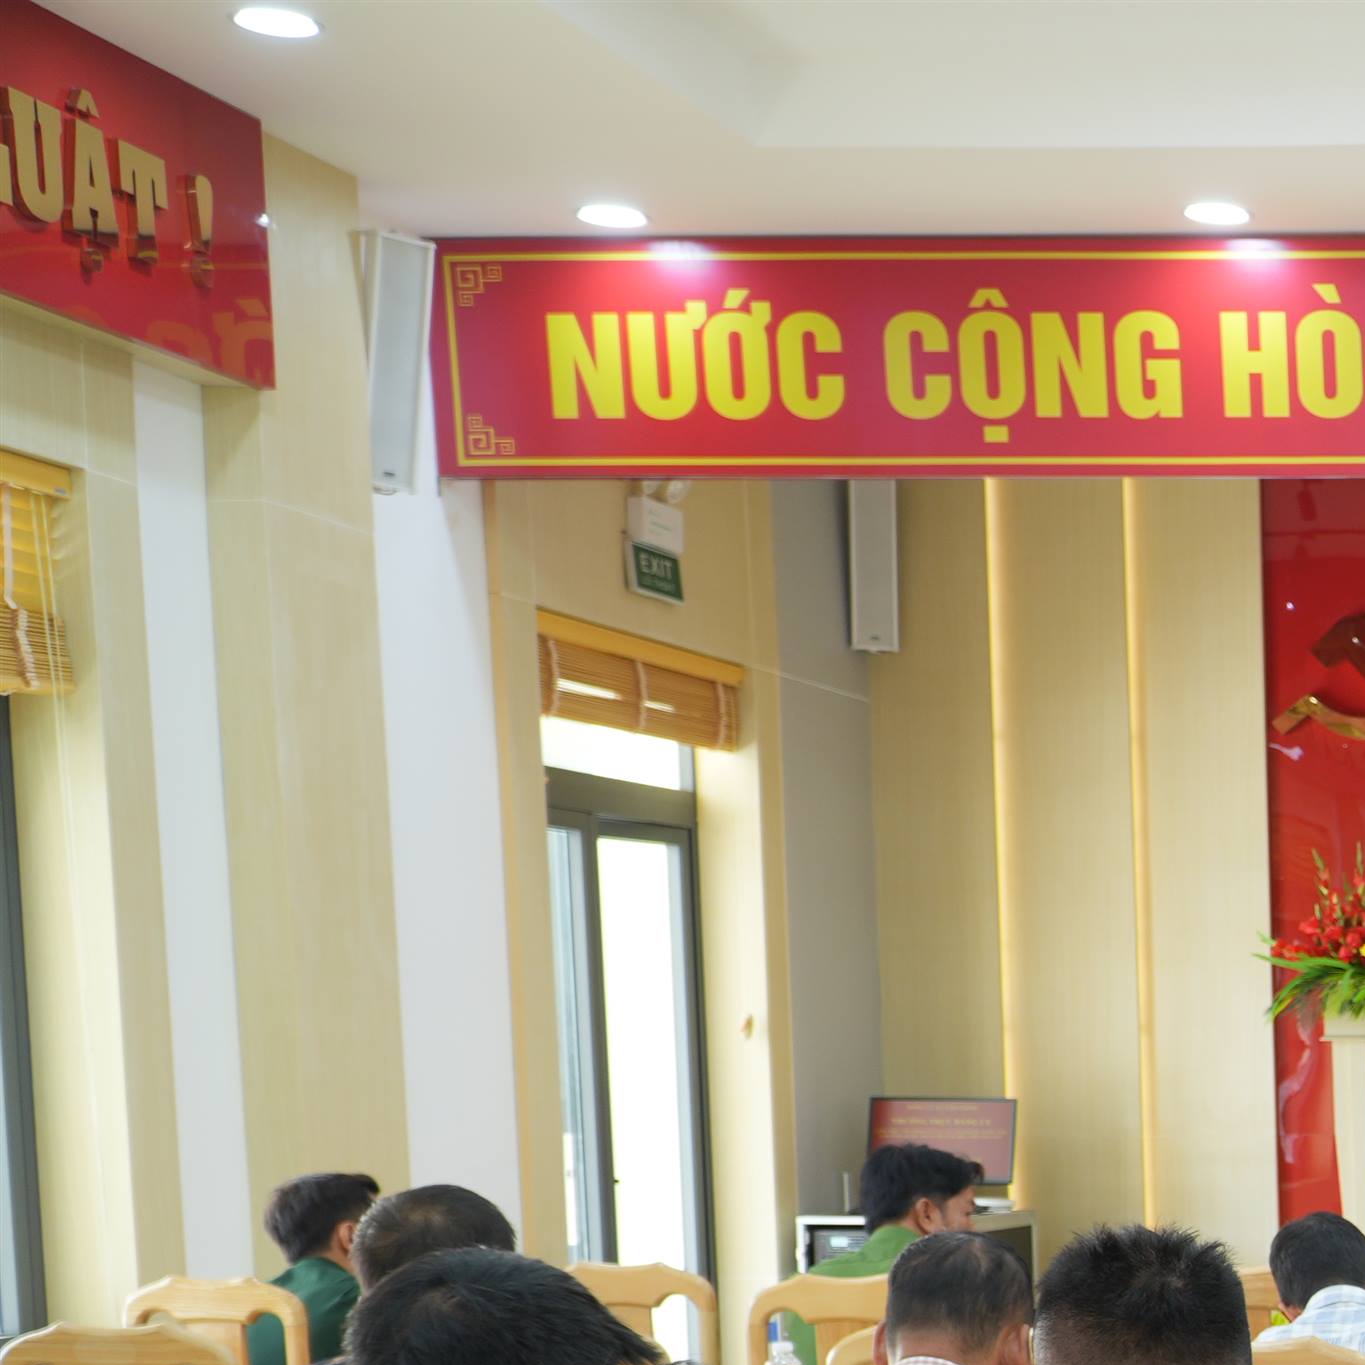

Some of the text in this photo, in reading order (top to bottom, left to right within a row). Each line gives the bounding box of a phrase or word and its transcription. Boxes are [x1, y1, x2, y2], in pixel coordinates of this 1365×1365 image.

[0, 85, 169, 272] UẬT
[545, 288, 846, 421] NƯỚC
[883, 288, 1184, 443] CỘNG
